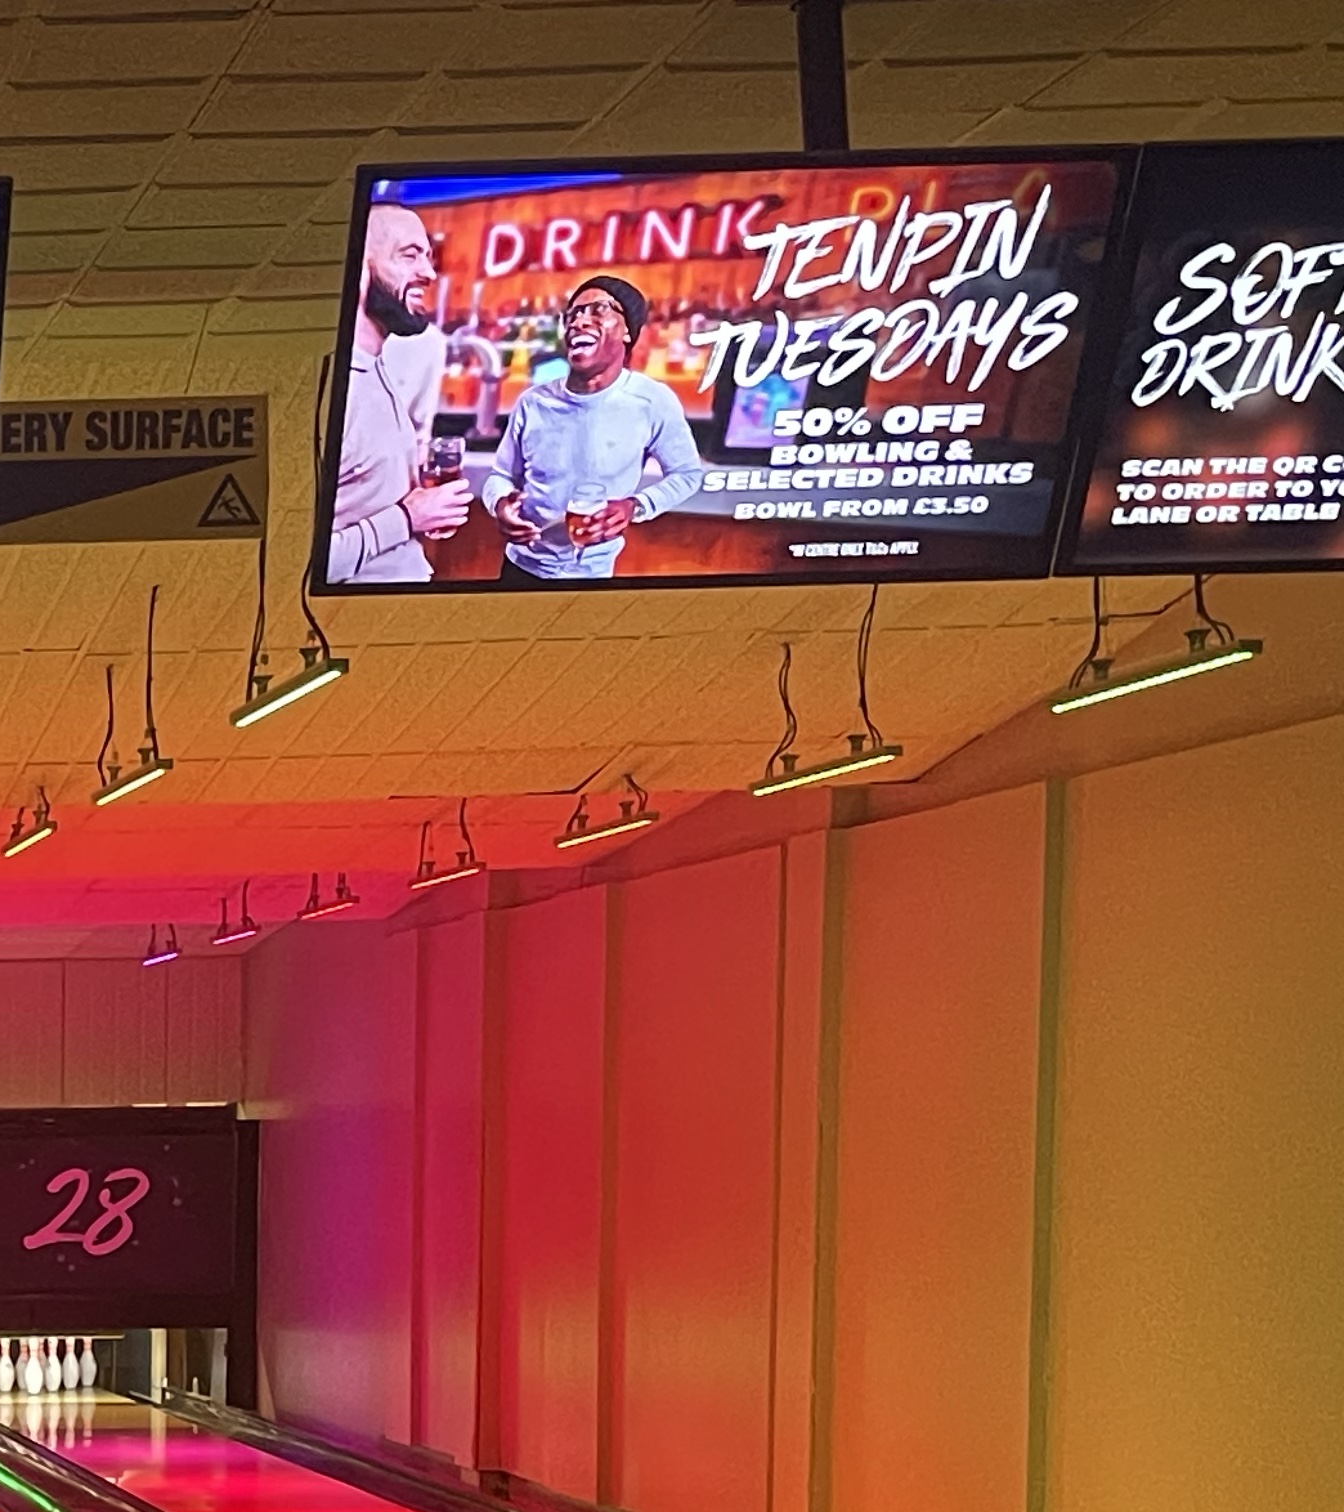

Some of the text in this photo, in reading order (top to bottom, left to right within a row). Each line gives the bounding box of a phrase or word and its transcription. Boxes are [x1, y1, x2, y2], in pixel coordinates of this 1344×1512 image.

[485, 200, 765, 277] DRINK
[743, 184, 1053, 302] TENPIN
[688, 291, 1080, 394] TUESDAYS
[85, 407, 255, 451] SURFACE
[773, 403, 985, 437] 50% OFF
[770, 438, 973, 466] BOWLING &
[1121, 458, 1204, 478] SCAN
[1209, 457, 1268, 475] THE
[1272, 455, 1318, 477] QR
[703, 462, 1035, 492] SELECTED DRINKS
[1116, 483, 1157, 502] TO
[1162, 480, 1269, 500] ORDER
[1274, 479, 1314, 498] TO
[733, 495, 989, 520] BOWL FROM £3.50
[1111, 502, 1341, 525] LANE OR TABLE
[23, 1168, 150, 1256] 28
